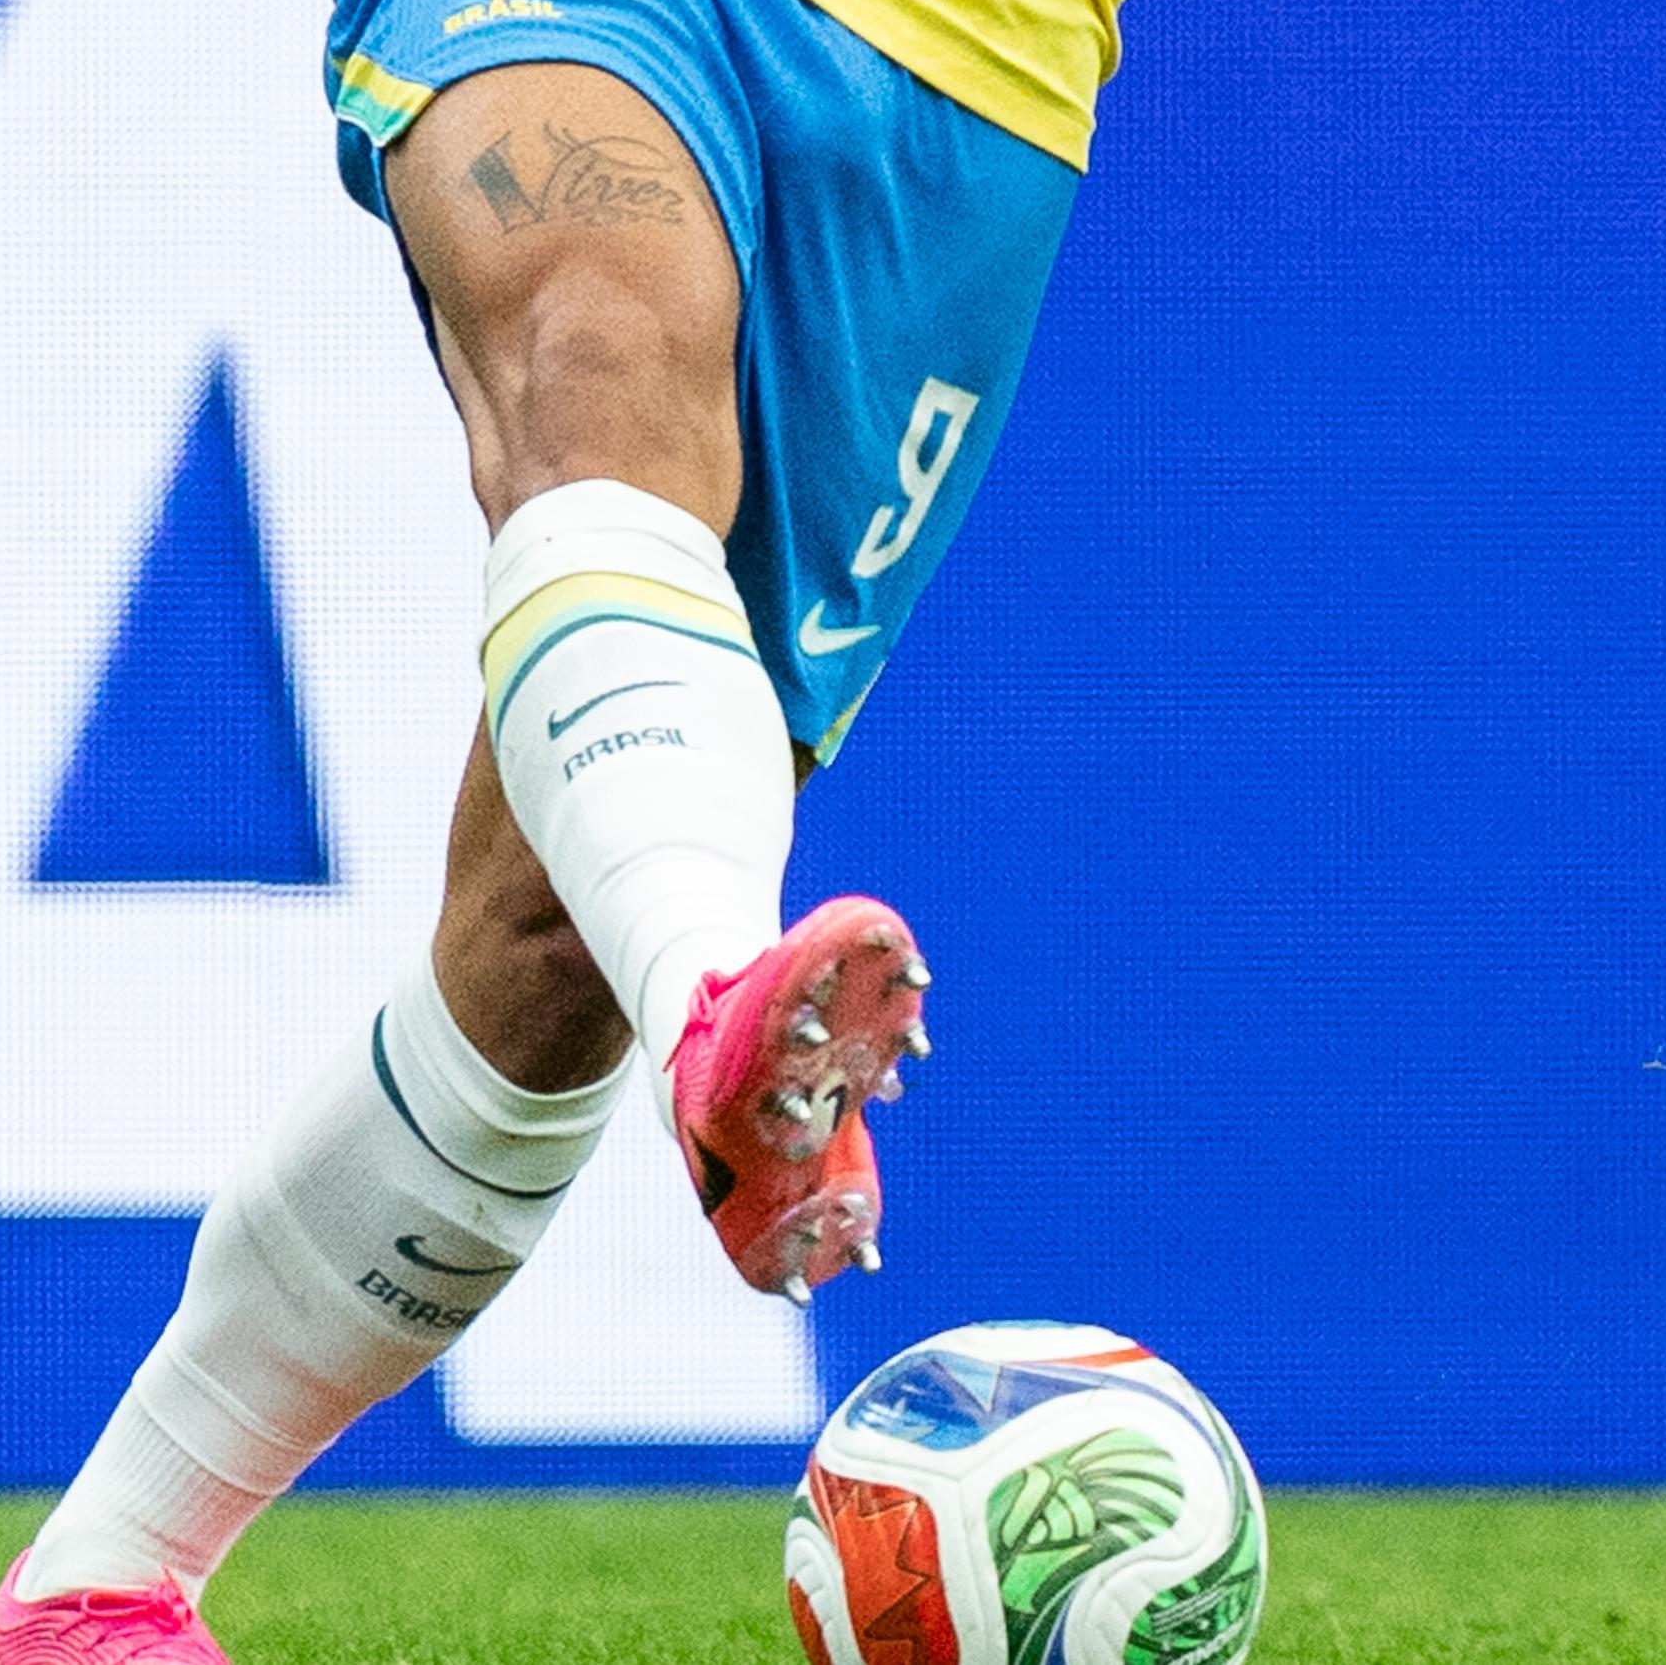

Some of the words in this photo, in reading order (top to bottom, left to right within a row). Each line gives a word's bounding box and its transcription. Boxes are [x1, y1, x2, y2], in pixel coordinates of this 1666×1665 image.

[850, 374, 980, 580] 9
[563, 726, 699, 784] BRASIL
[355, 1268, 481, 1328] BRASI
